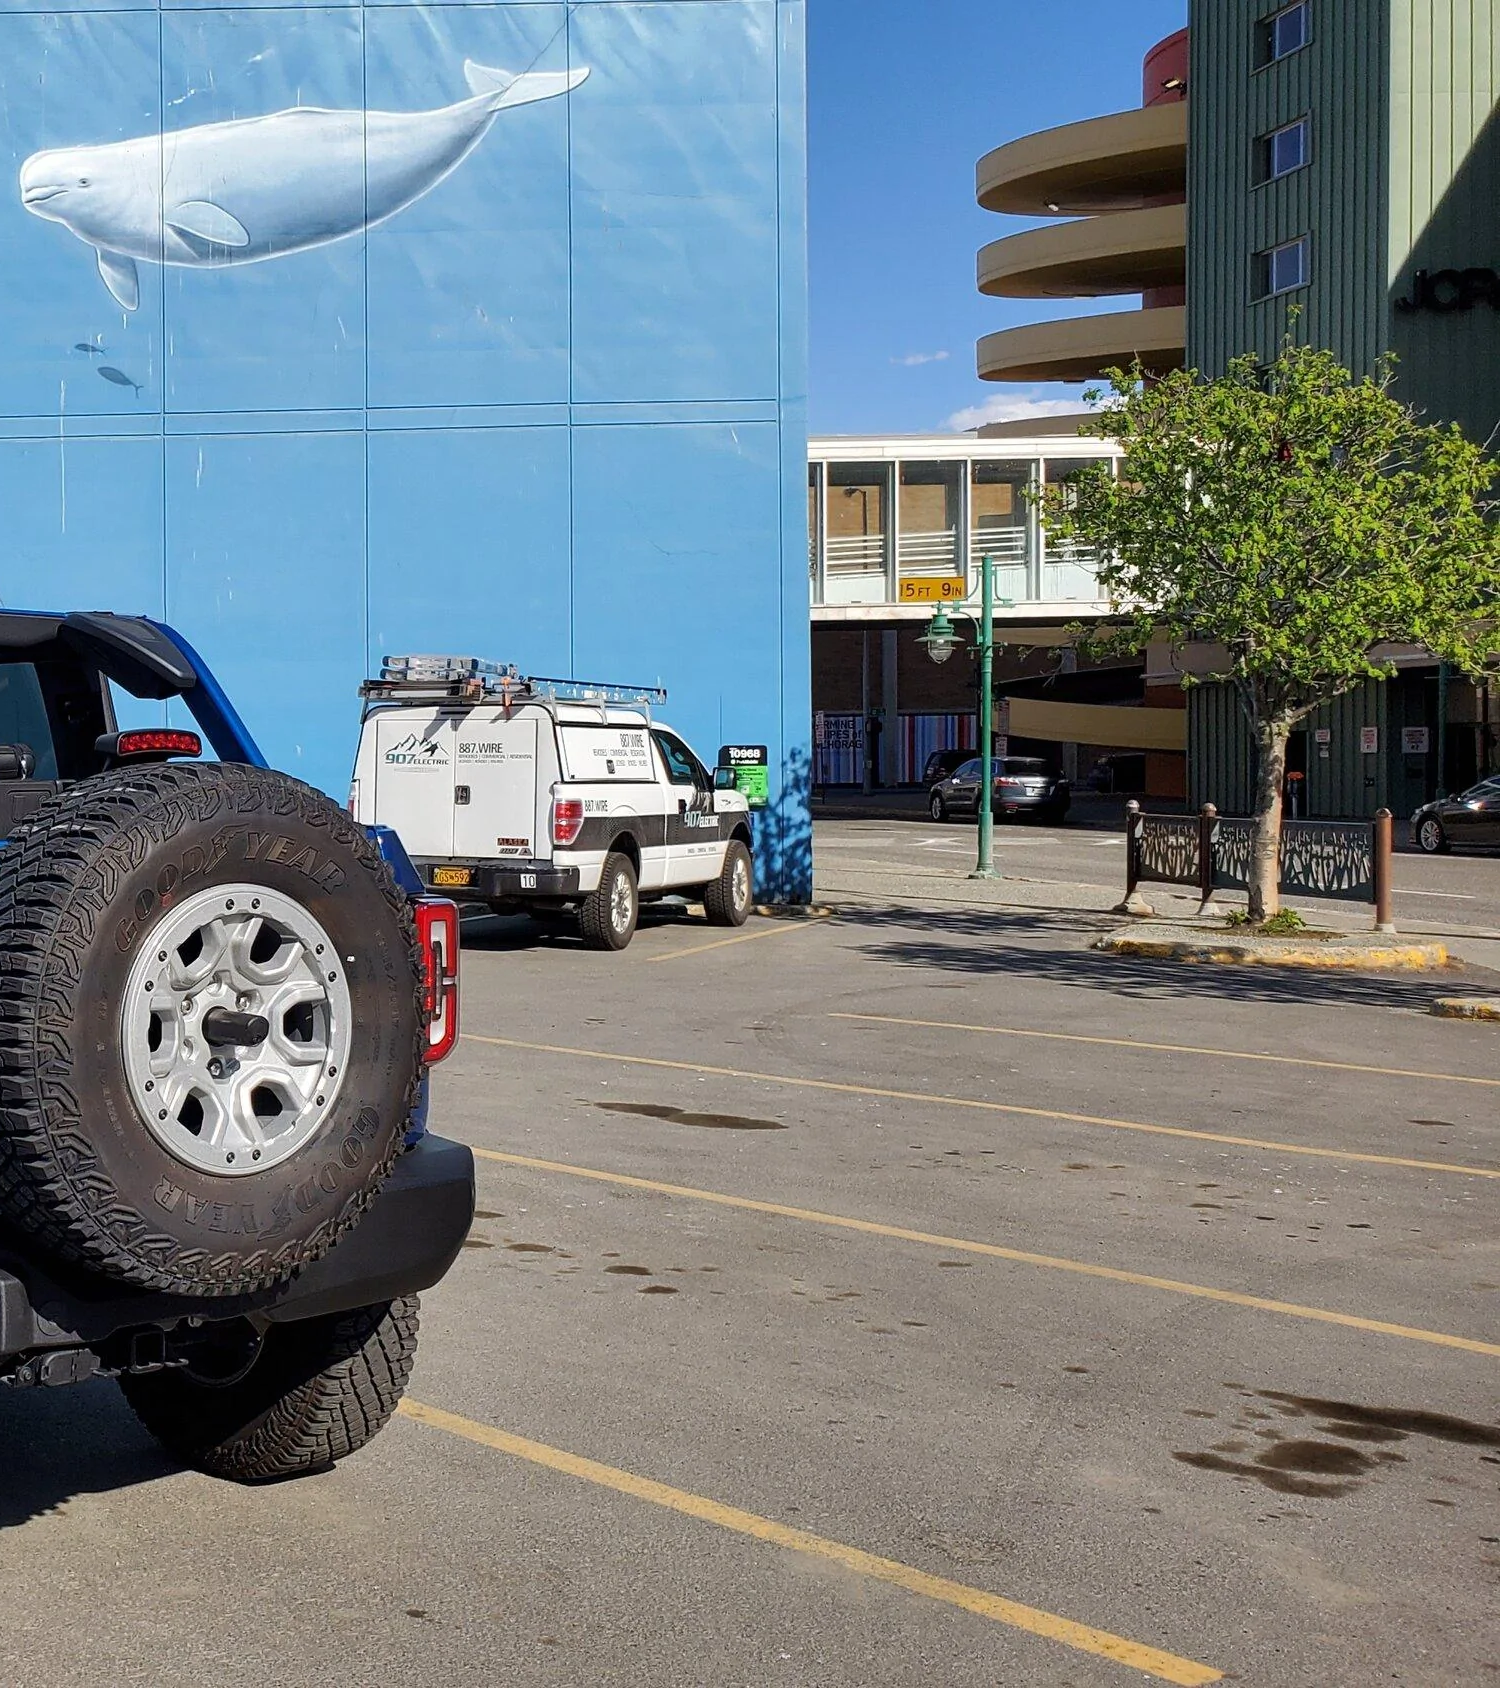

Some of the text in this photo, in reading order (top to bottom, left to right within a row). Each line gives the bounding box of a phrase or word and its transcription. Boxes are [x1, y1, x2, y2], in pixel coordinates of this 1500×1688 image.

[620, 733, 645, 748] 887.WIRE
[459, 743, 503, 753] 887.WIRE
[729, 749, 761, 758] 10968
[385, 754, 416, 765] 907
[584, 800, 608, 812] 887.WIRE
[684, 811, 719, 827] 907 ELECTRIC
[499, 837, 528, 846] ALASKA
[522, 875, 536, 887] 10
